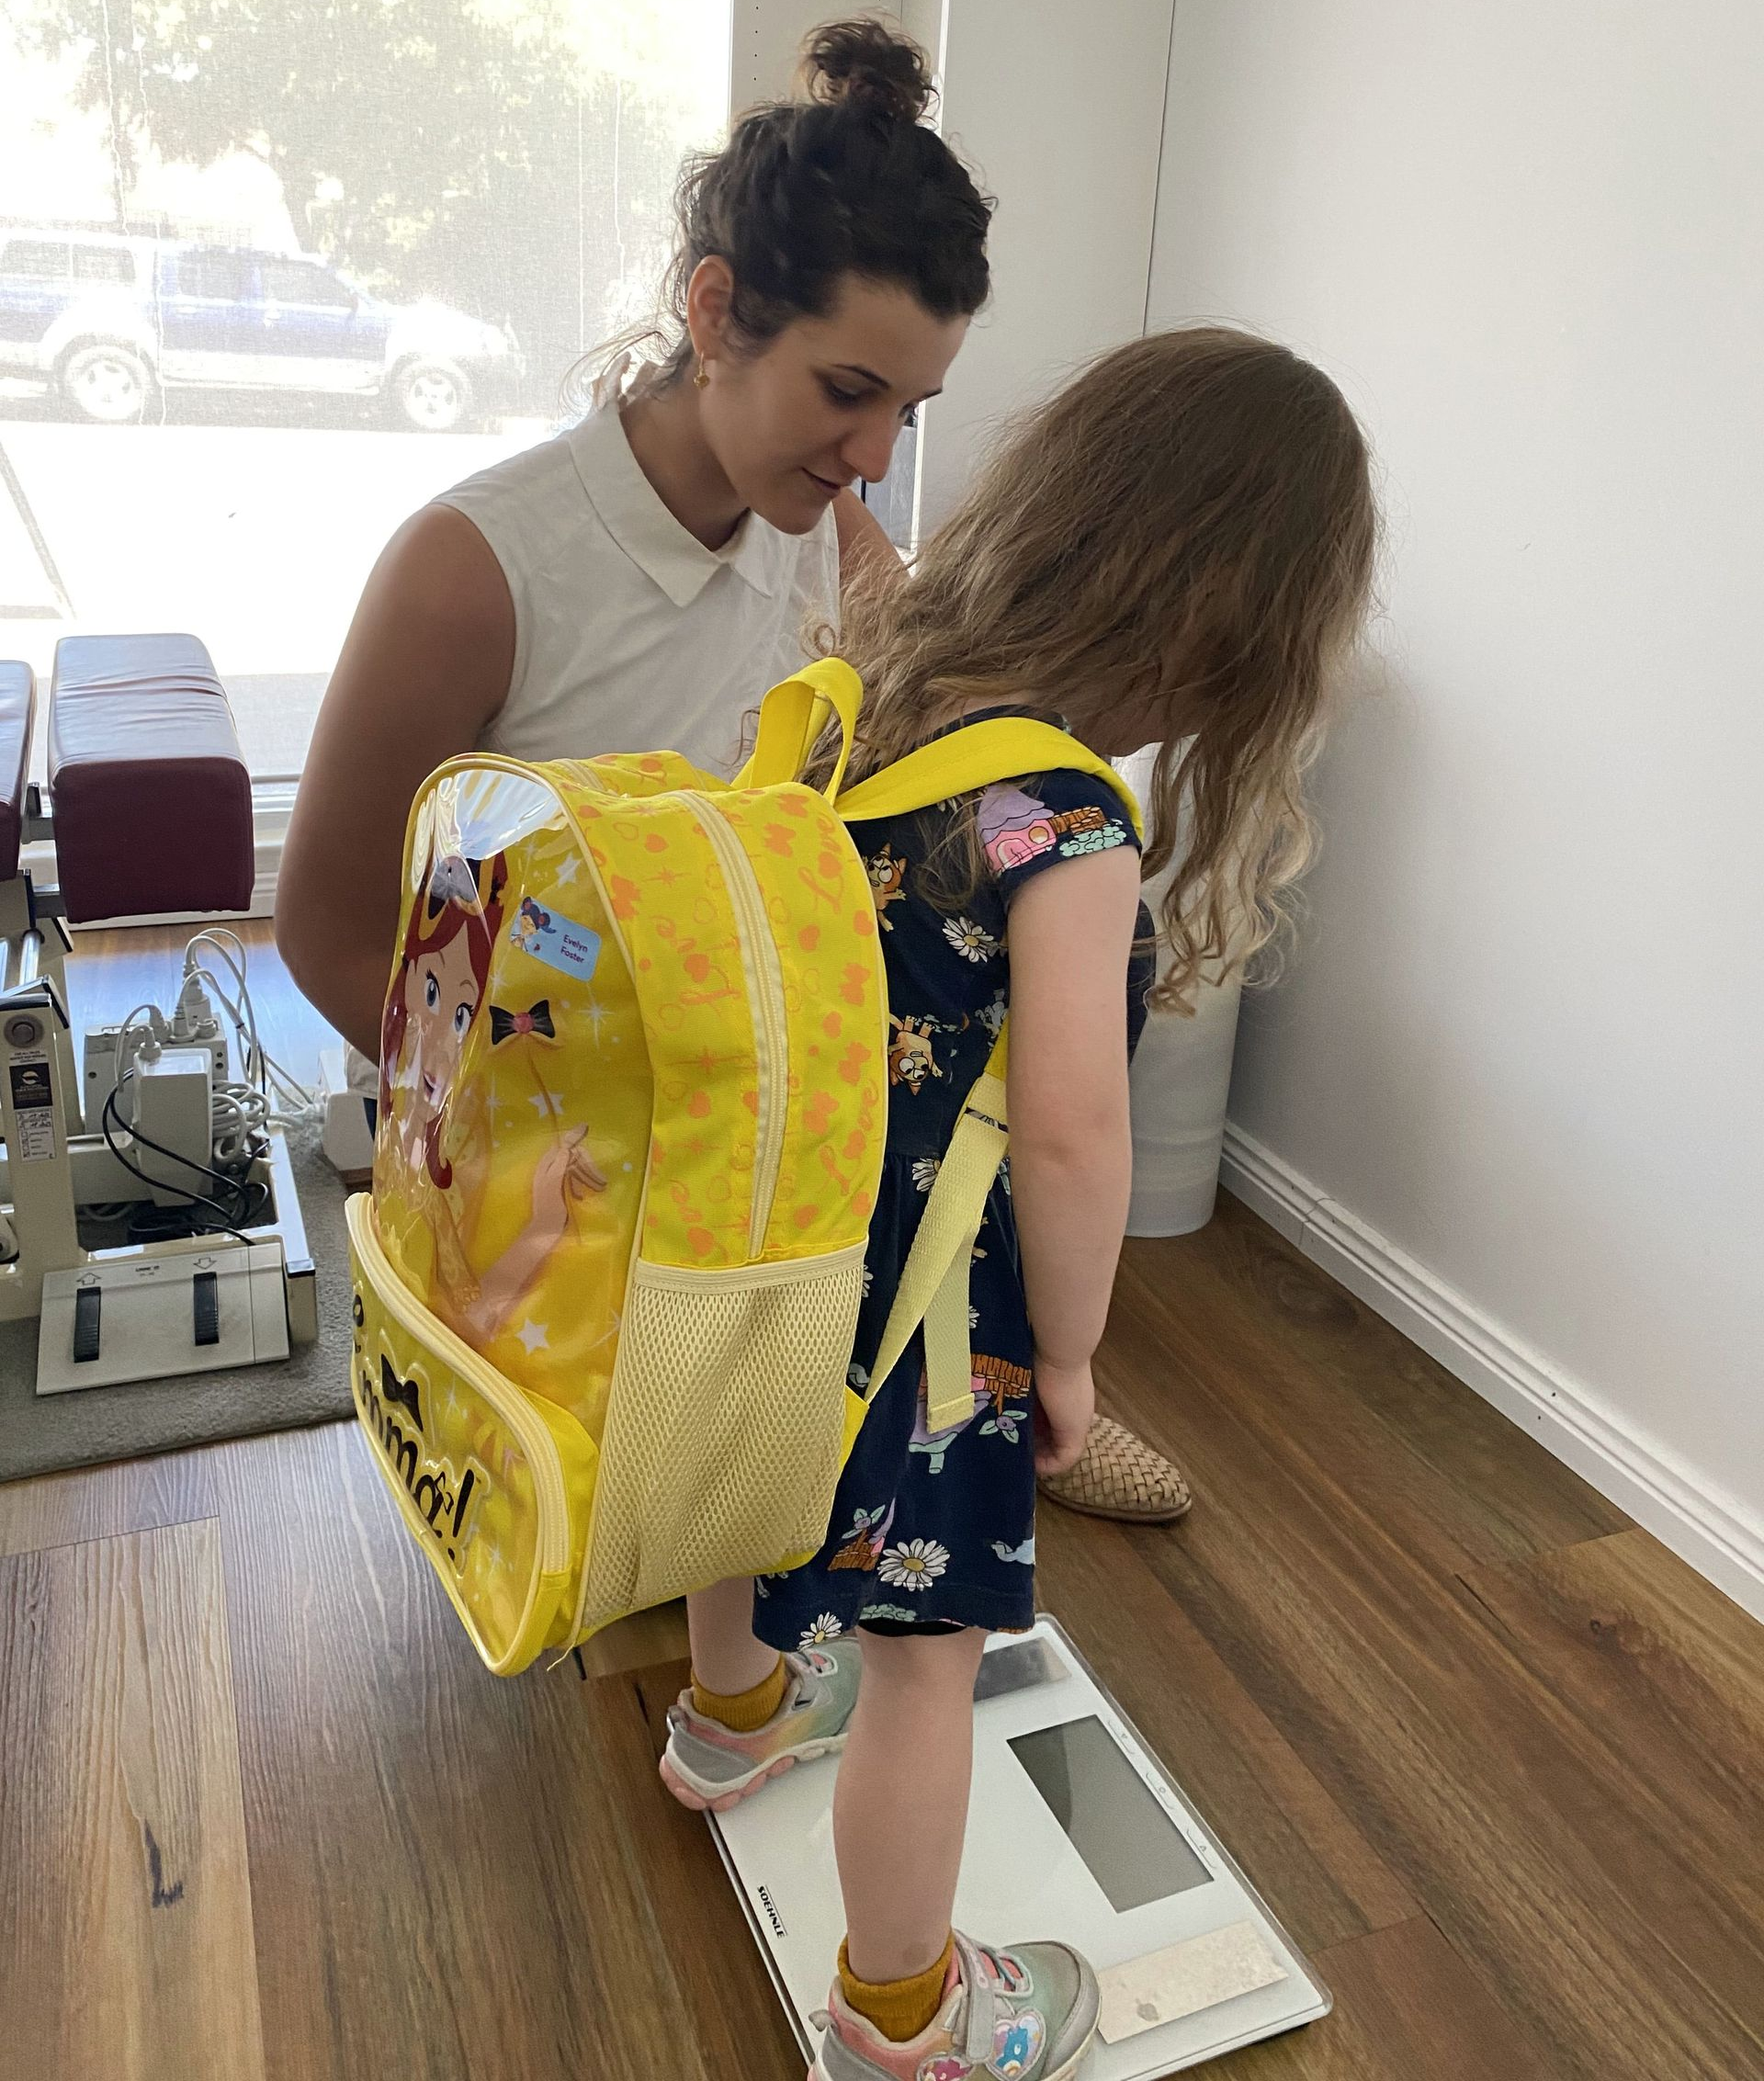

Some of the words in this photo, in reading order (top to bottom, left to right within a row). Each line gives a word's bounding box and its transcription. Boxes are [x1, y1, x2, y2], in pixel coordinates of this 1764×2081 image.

[561, 946, 585, 963] Foster
[563, 934, 588, 953] Evelyn
[354, 1295, 474, 1561] mma!
[757, 1886, 785, 1939] SOEHNLE
